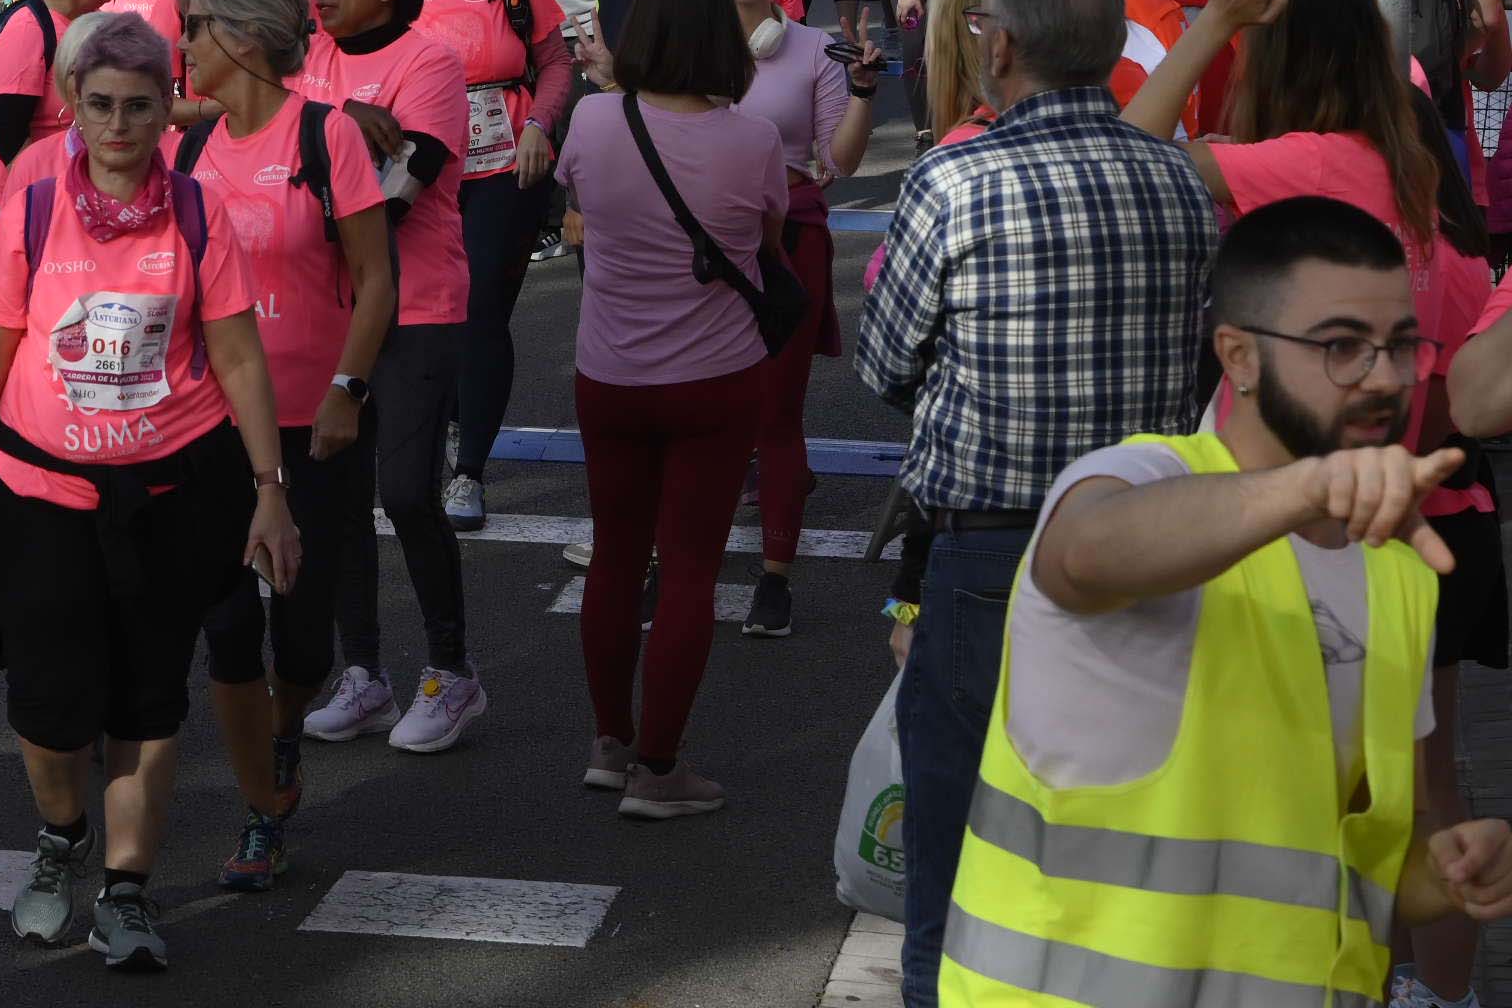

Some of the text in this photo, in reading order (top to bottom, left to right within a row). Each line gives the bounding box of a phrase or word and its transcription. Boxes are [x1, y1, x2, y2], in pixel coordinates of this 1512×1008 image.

[44, 259, 96, 274] OYSHO
[92, 311, 138, 325] ASTURIANA
[92, 338, 131, 356] 016
[97, 374, 109, 383] DE
[109, 375, 119, 383] LA
[64, 412, 157, 453] SUMA
